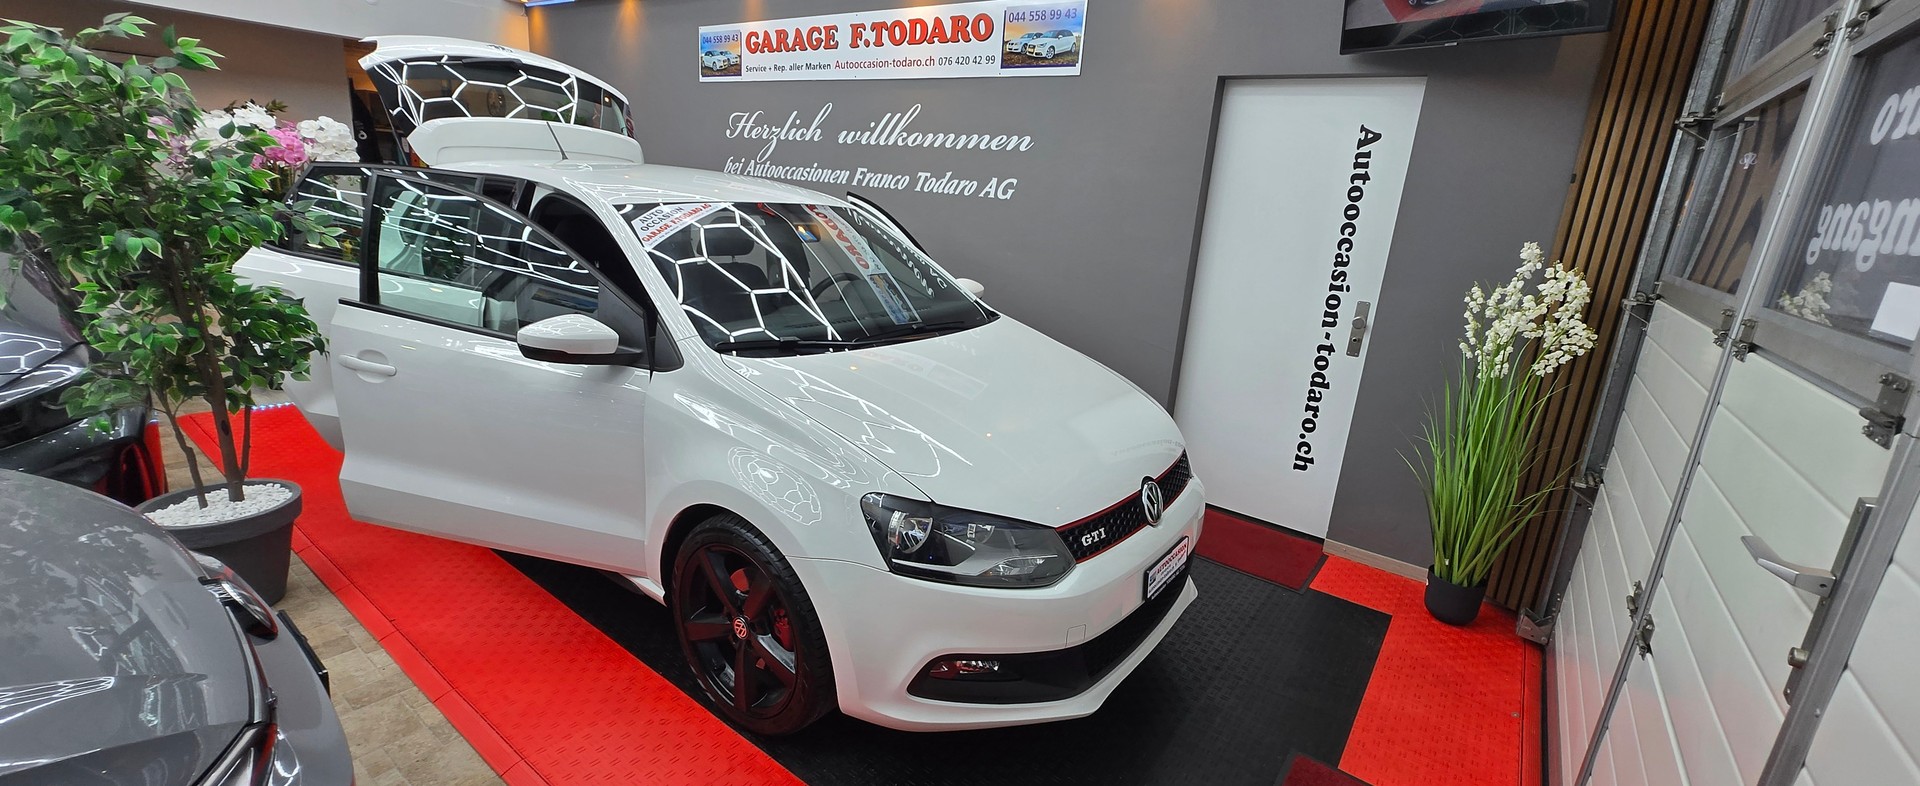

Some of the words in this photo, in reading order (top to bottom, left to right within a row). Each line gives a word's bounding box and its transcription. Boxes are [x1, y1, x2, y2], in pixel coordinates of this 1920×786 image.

[1008, 12, 1026, 23] 044
[1029, 10, 1047, 21] 558
[1049, 9, 1062, 20] 99
[1064, 8, 1078, 19] 43
[702, 36, 712, 45] 044
[713, 35, 723, 44] 558
[724, 34, 731, 43] 99
[731, 34, 738, 42] 43
[745, 25, 839, 54] GARAGE
[849, 13, 995, 48] F.TODARO
[745, 64, 767, 73] Service
[773, 63, 788, 73] Rep.
[788, 62, 804, 71] aller
[805, 61, 832, 71] Marken
[834, 55, 936, 70] Autooccasion-todaro.ch
[938, 56, 953, 66] 076
[955, 56, 970, 66] 420
[972, 55, 983, 65] 42
[985, 54, 996, 65] 99
[725, 102, 833, 163] Herzlich
[837, 103, 1035, 152] willkommen
[723, 156, 742, 176] bei
[744, 159, 849, 185] Autooccasionen
[851, 167, 910, 191] Franco
[913, 171, 977, 197] Todaro
[978, 177, 1018, 200] AG
[639, 208, 665, 225] AUTO
[640, 206, 685, 232] OCCASION
[1292, 123, 1382, 473] Autooccasion-todaro.ch
[1081, 527, 1107, 547] GTI
